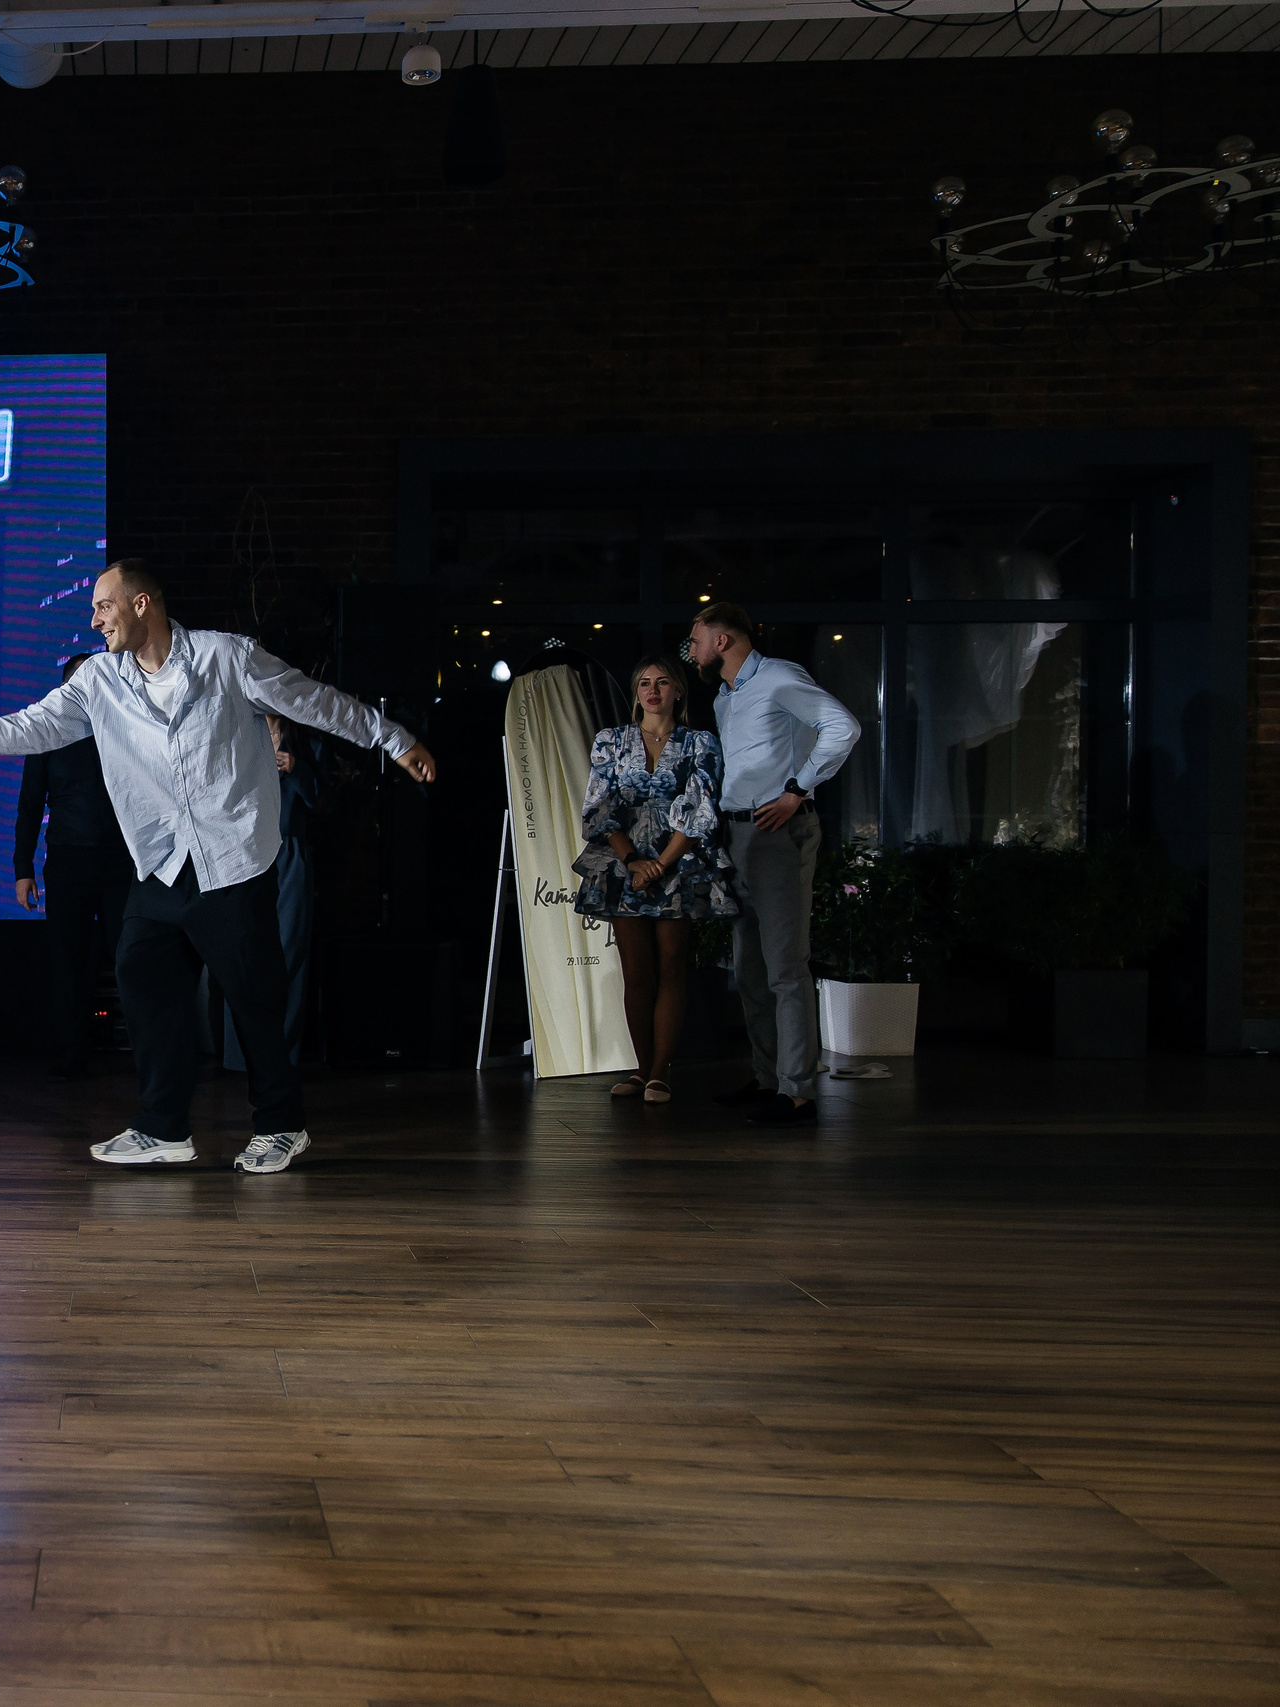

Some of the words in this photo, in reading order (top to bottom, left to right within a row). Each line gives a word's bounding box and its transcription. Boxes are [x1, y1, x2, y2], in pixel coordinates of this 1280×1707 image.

[520, 754, 531, 773] НА
[522, 776, 537, 839] ВІТАЄМО
[566, 956, 600, 966] 29.11.2025
